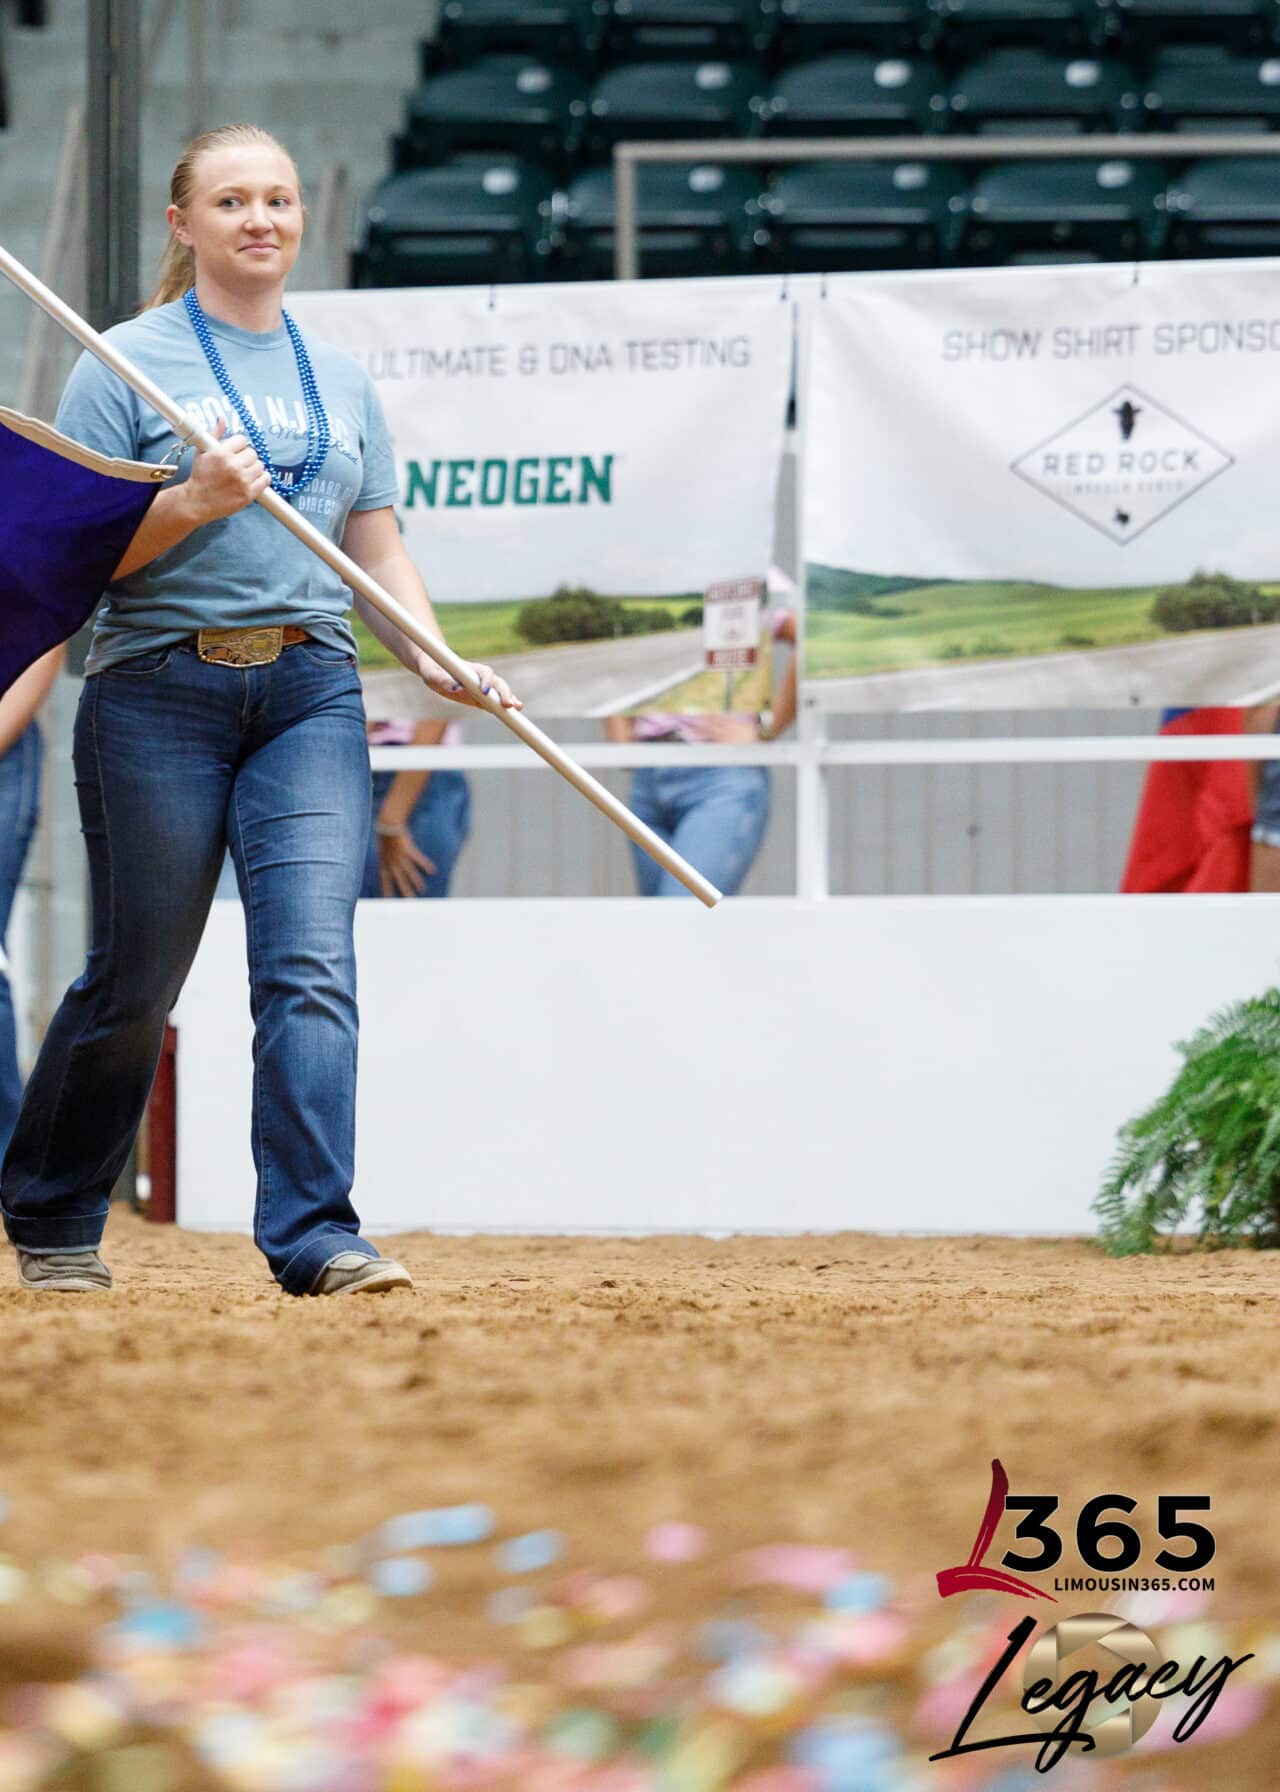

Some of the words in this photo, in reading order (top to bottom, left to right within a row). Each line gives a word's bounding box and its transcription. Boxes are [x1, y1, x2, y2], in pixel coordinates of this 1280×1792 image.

[367, 343, 507, 381] ULTIMATE
[548, 340, 613, 376] DNA
[624, 336, 752, 373] TESTING
[942, 327, 1042, 363] SHOW
[1052, 324, 1141, 360] SHIRT
[404, 454, 614, 509] NEOGEN
[1042, 452, 1106, 476] RED
[1119, 448, 1200, 474] ROCK
